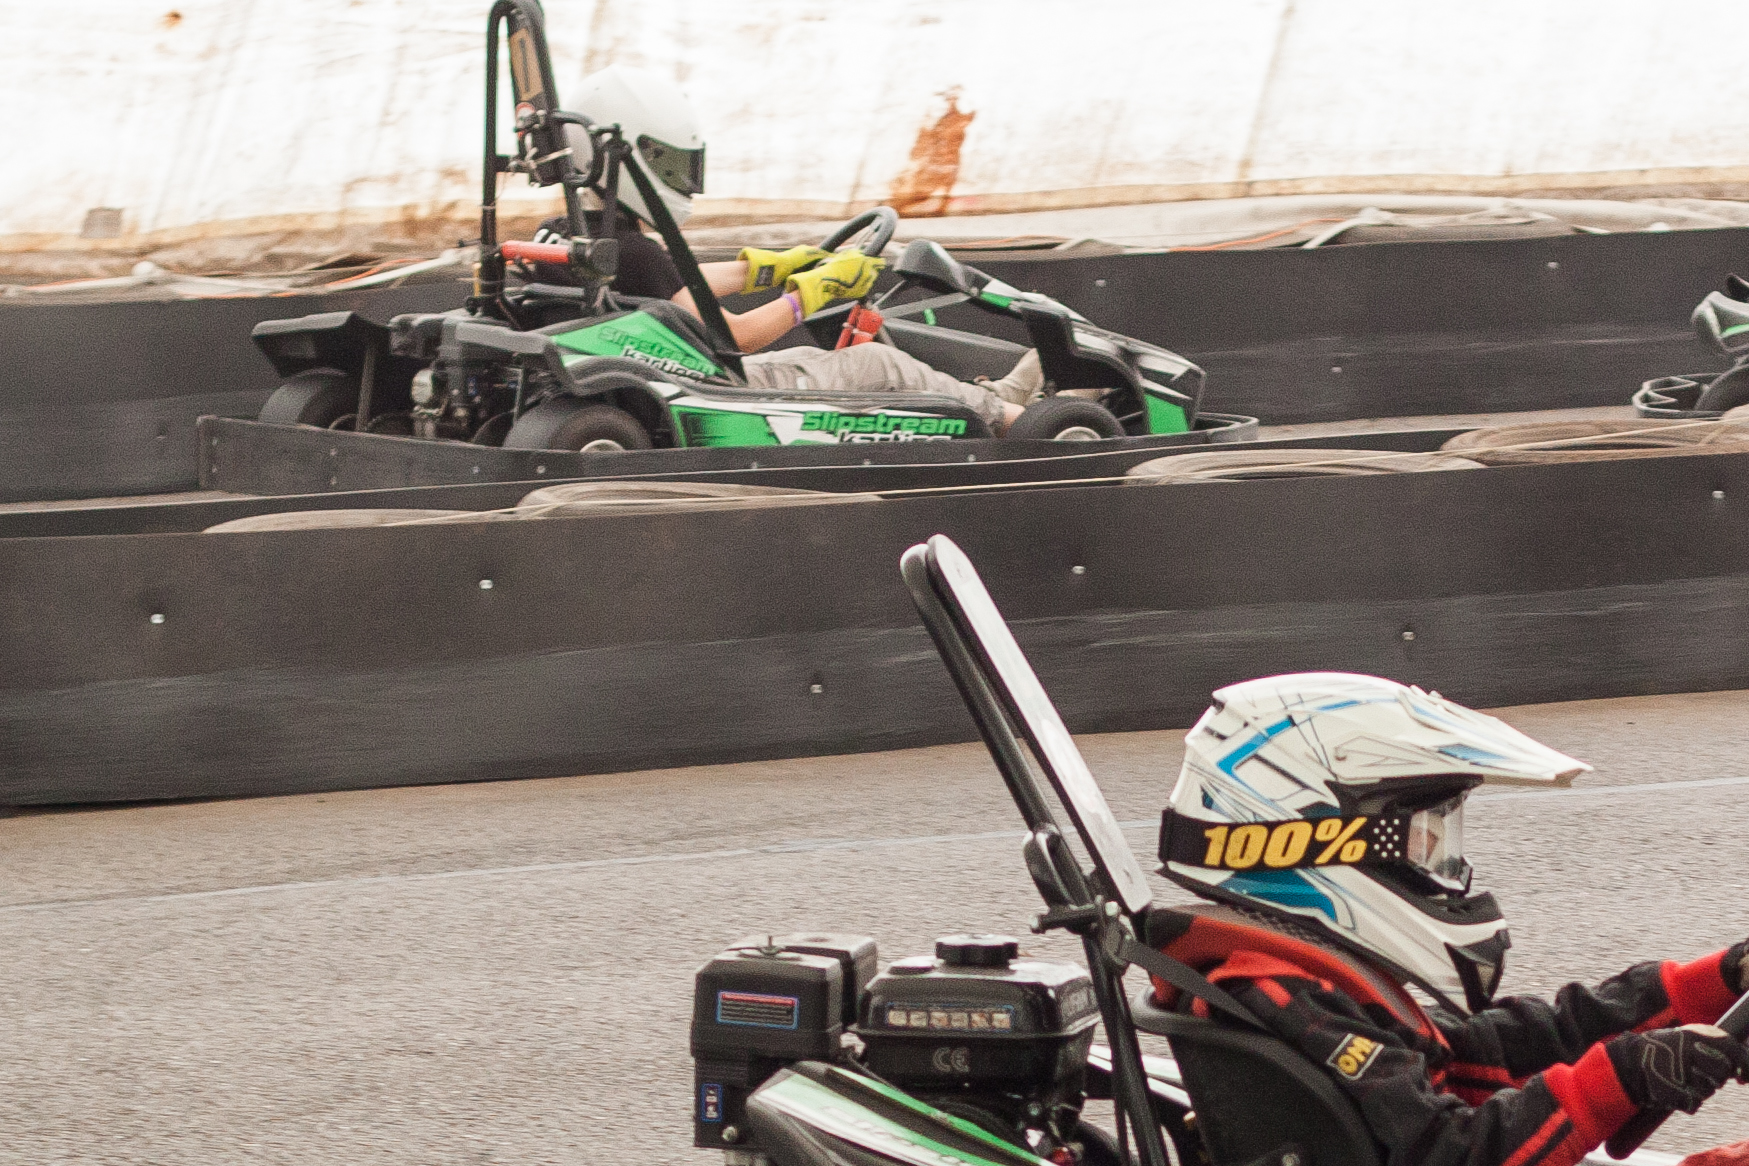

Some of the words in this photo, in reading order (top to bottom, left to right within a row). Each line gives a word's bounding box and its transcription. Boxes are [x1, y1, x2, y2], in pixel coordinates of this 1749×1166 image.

[801, 411, 968, 437] Slipstream
[1204, 816, 1368, 869] 100%
[1337, 1035, 1378, 1075] OM
